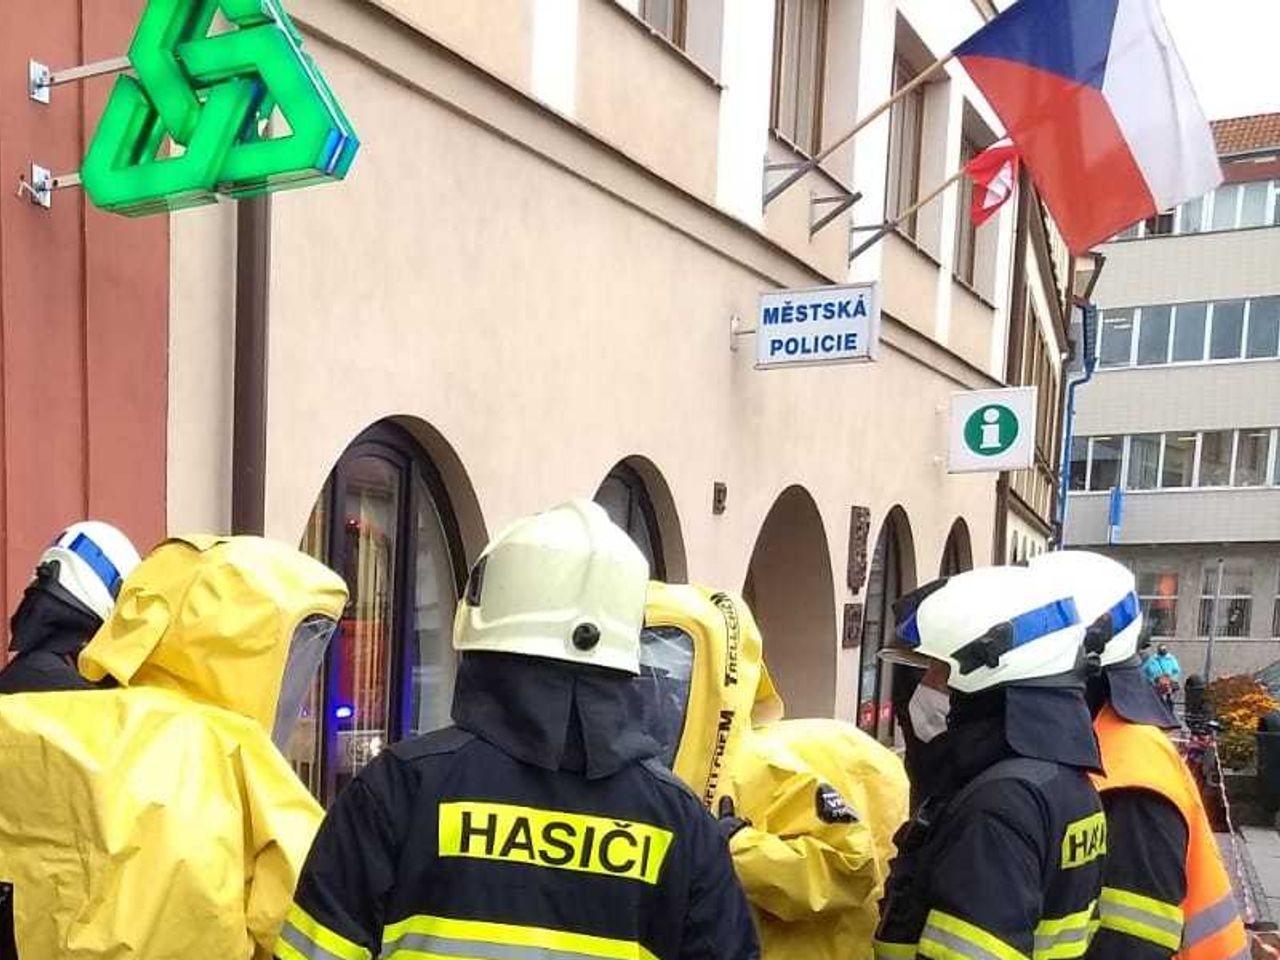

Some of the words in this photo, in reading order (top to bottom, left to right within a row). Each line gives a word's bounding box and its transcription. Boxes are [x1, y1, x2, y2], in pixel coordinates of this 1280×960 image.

[762, 294, 867, 325] MĚSTSKÁ
[769, 333, 858, 356] POLICIE
[459, 811, 651, 877] HASIČI
